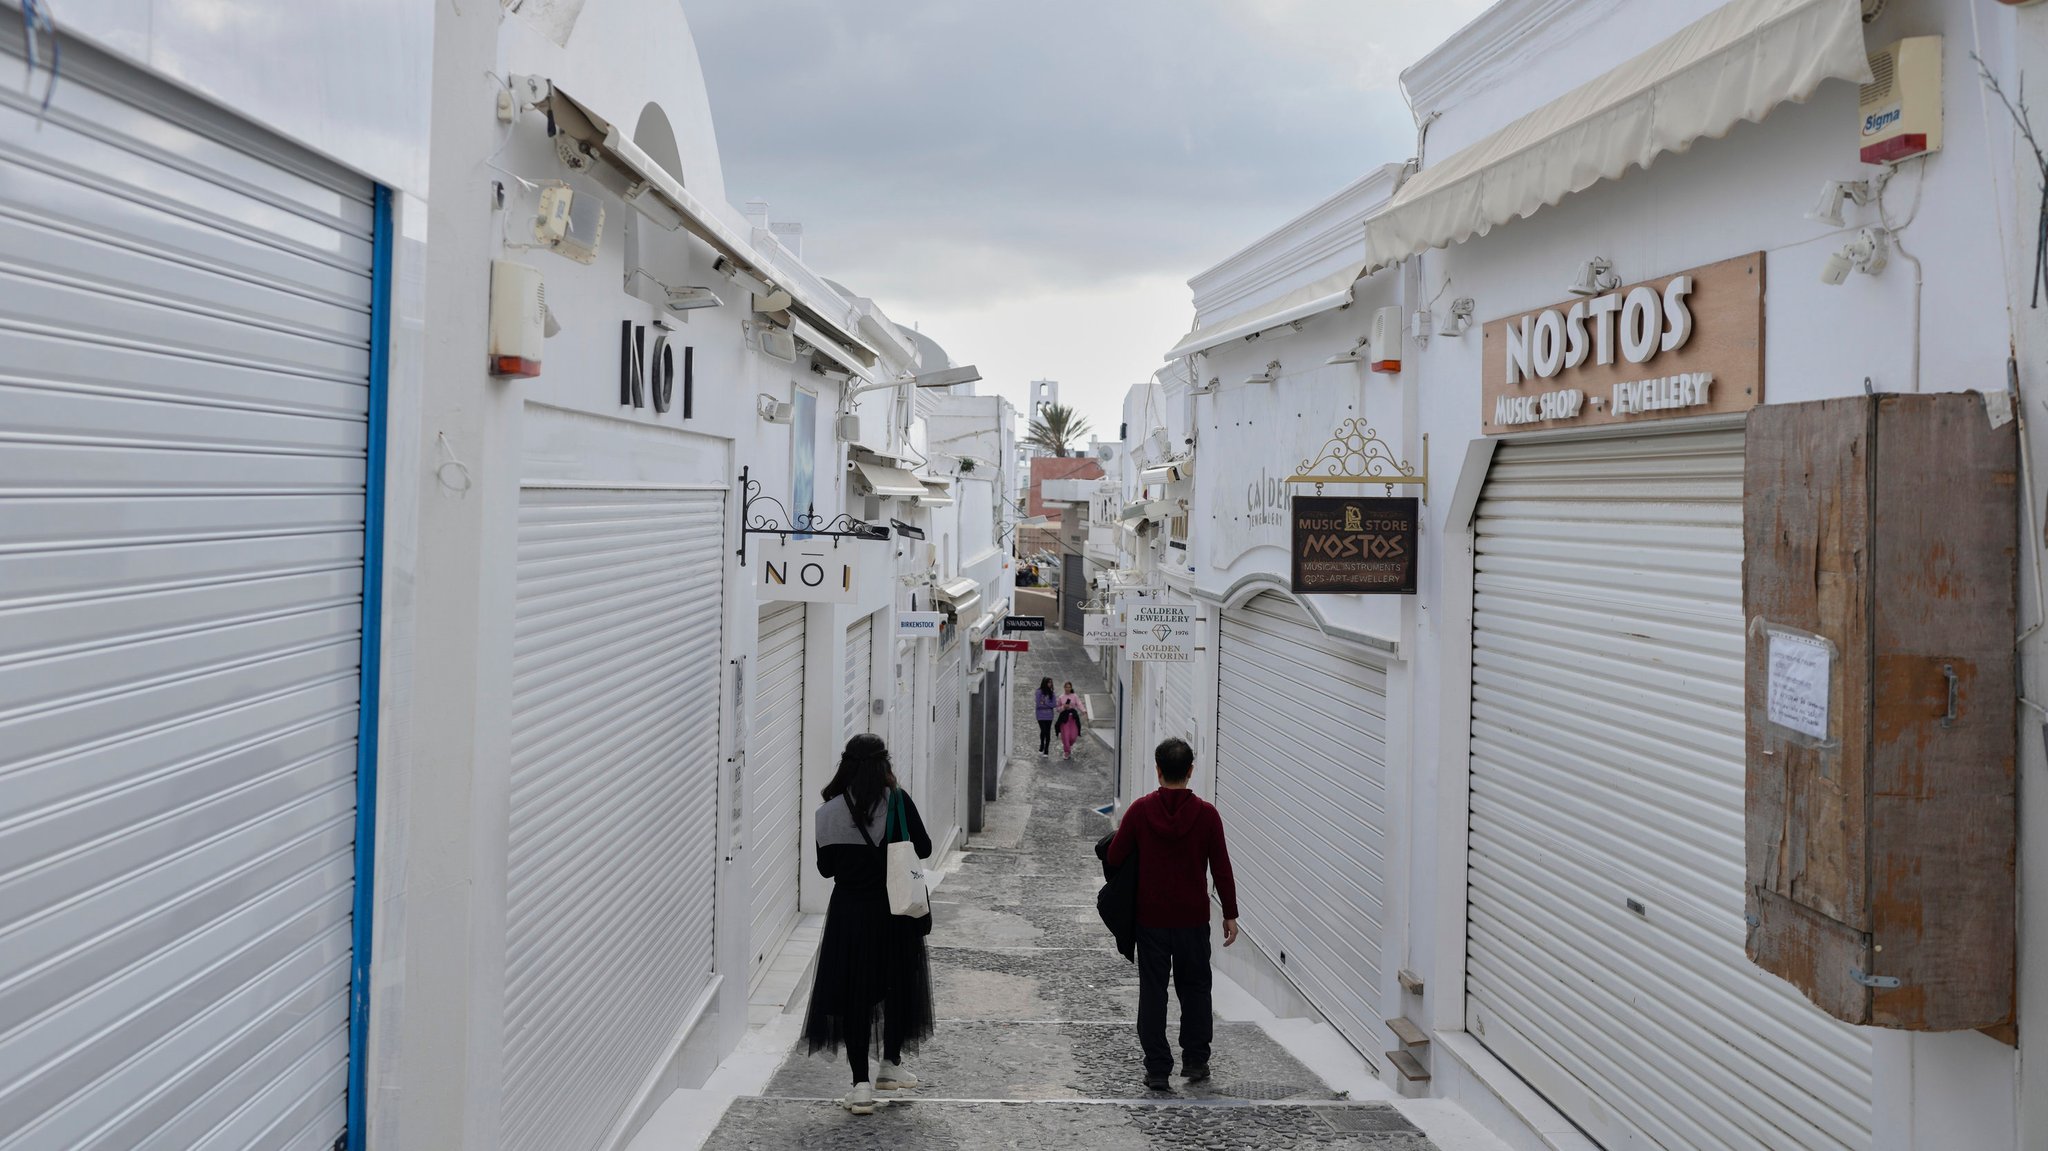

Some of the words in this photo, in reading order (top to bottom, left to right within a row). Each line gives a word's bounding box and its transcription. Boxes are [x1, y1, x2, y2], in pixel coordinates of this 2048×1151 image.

[1866, 109, 1900, 130] Sigma
[1506, 275, 1692, 384] NOSTOS
[1494, 394, 1539, 425] MUSIC
[1539, 389, 1583, 420] SHOP
[1611, 372, 1712, 416] JEWELLERY
[1299, 519, 1342, 531] MUSIC
[1366, 520, 1408, 531] STORE
[1303, 533, 1404, 559] NOSTOS
[1304, 562, 1341, 572] MUSICAL
[1343, 562, 1401, 572] INSTRUMENTS
[1140, 607, 1184, 615] CALDERA
[1134, 615, 1190, 623] JEWELLERY
[900, 621, 935, 629] BIRKENSTOCK
[1005, 620, 1044, 629] SWAROVSKI
[1141, 644, 1181, 652] GOLDEN
[1133, 652, 1189, 660] SANTORINI
